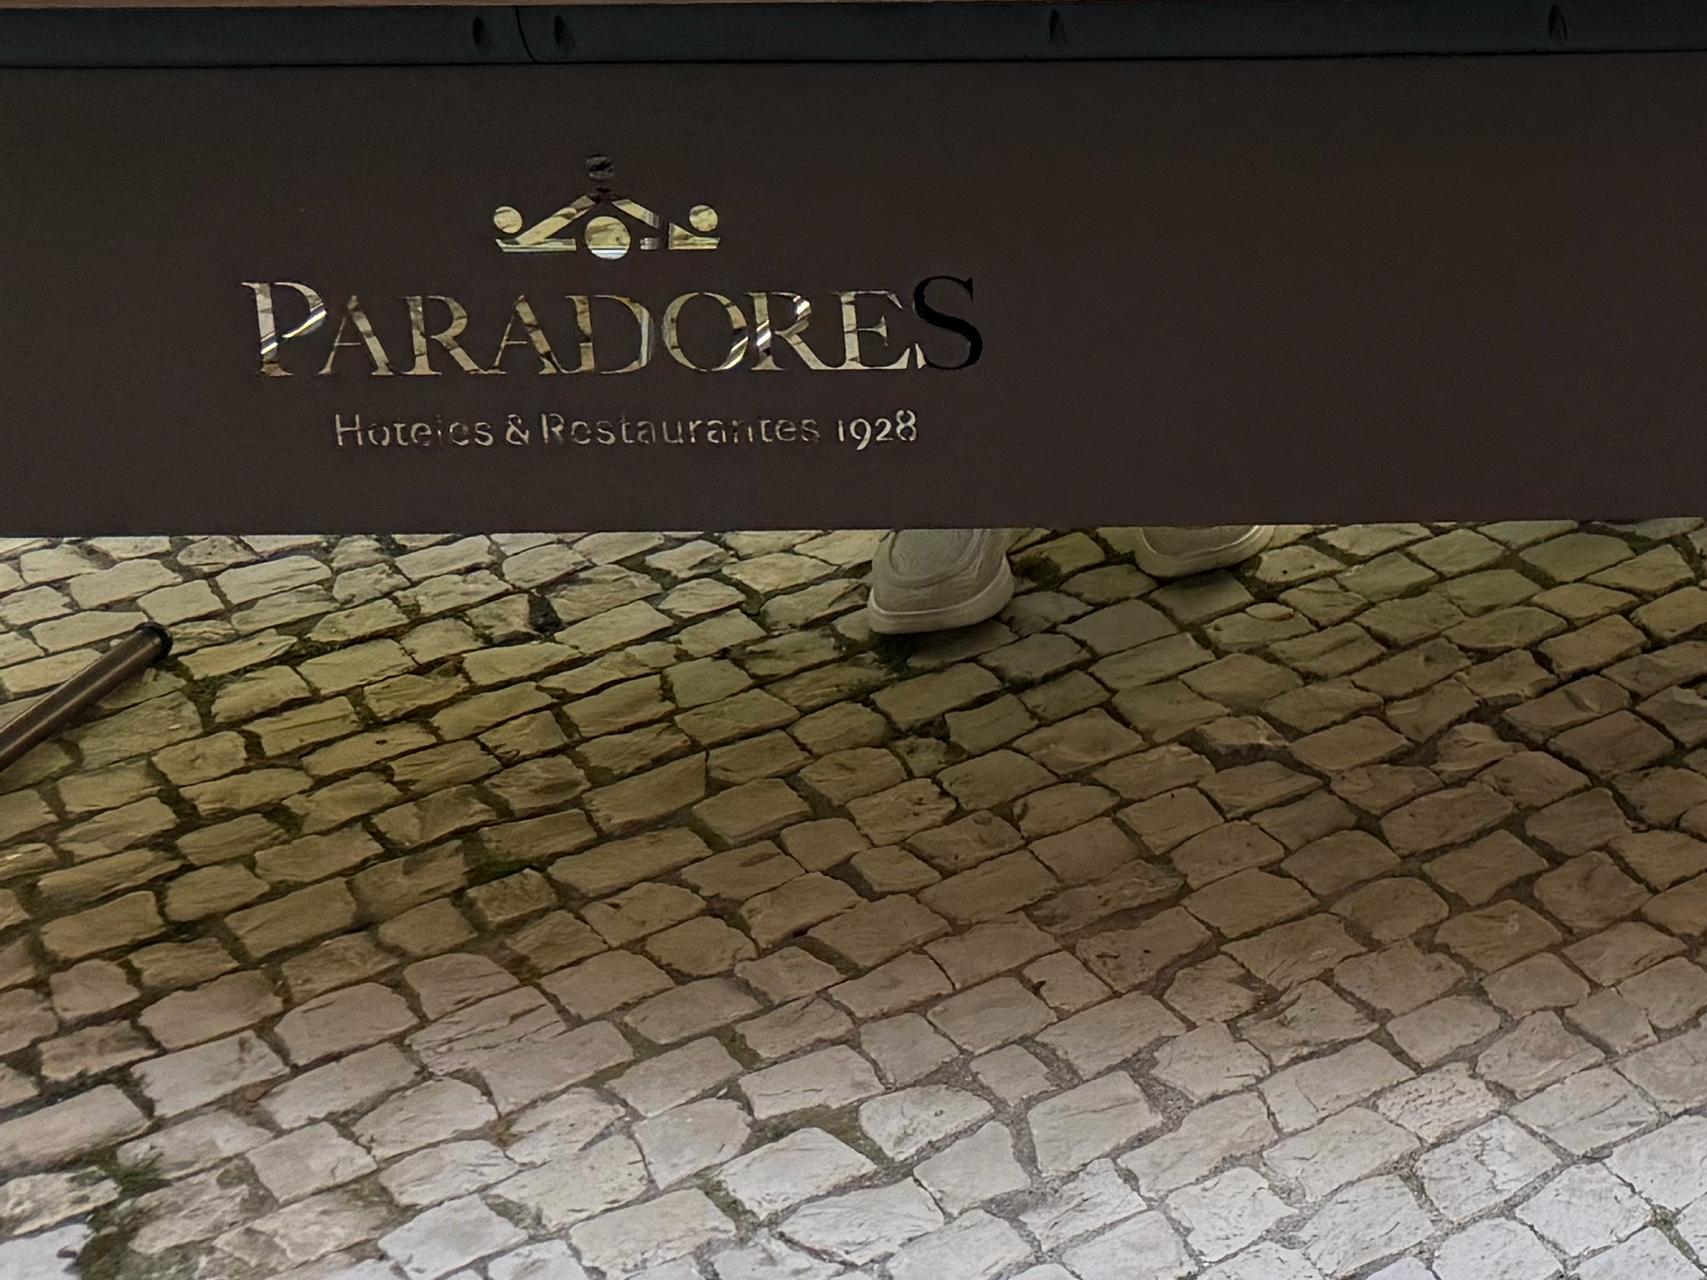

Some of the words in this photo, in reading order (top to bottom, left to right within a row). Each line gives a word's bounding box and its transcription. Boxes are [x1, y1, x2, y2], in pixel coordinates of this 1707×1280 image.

[240, 274, 984, 378] PARADORES
[334, 413, 494, 447] Hoteles
[504, 413, 530, 446] &
[540, 411, 821, 446] Restaurantes
[836, 408, 918, 452] 1928
